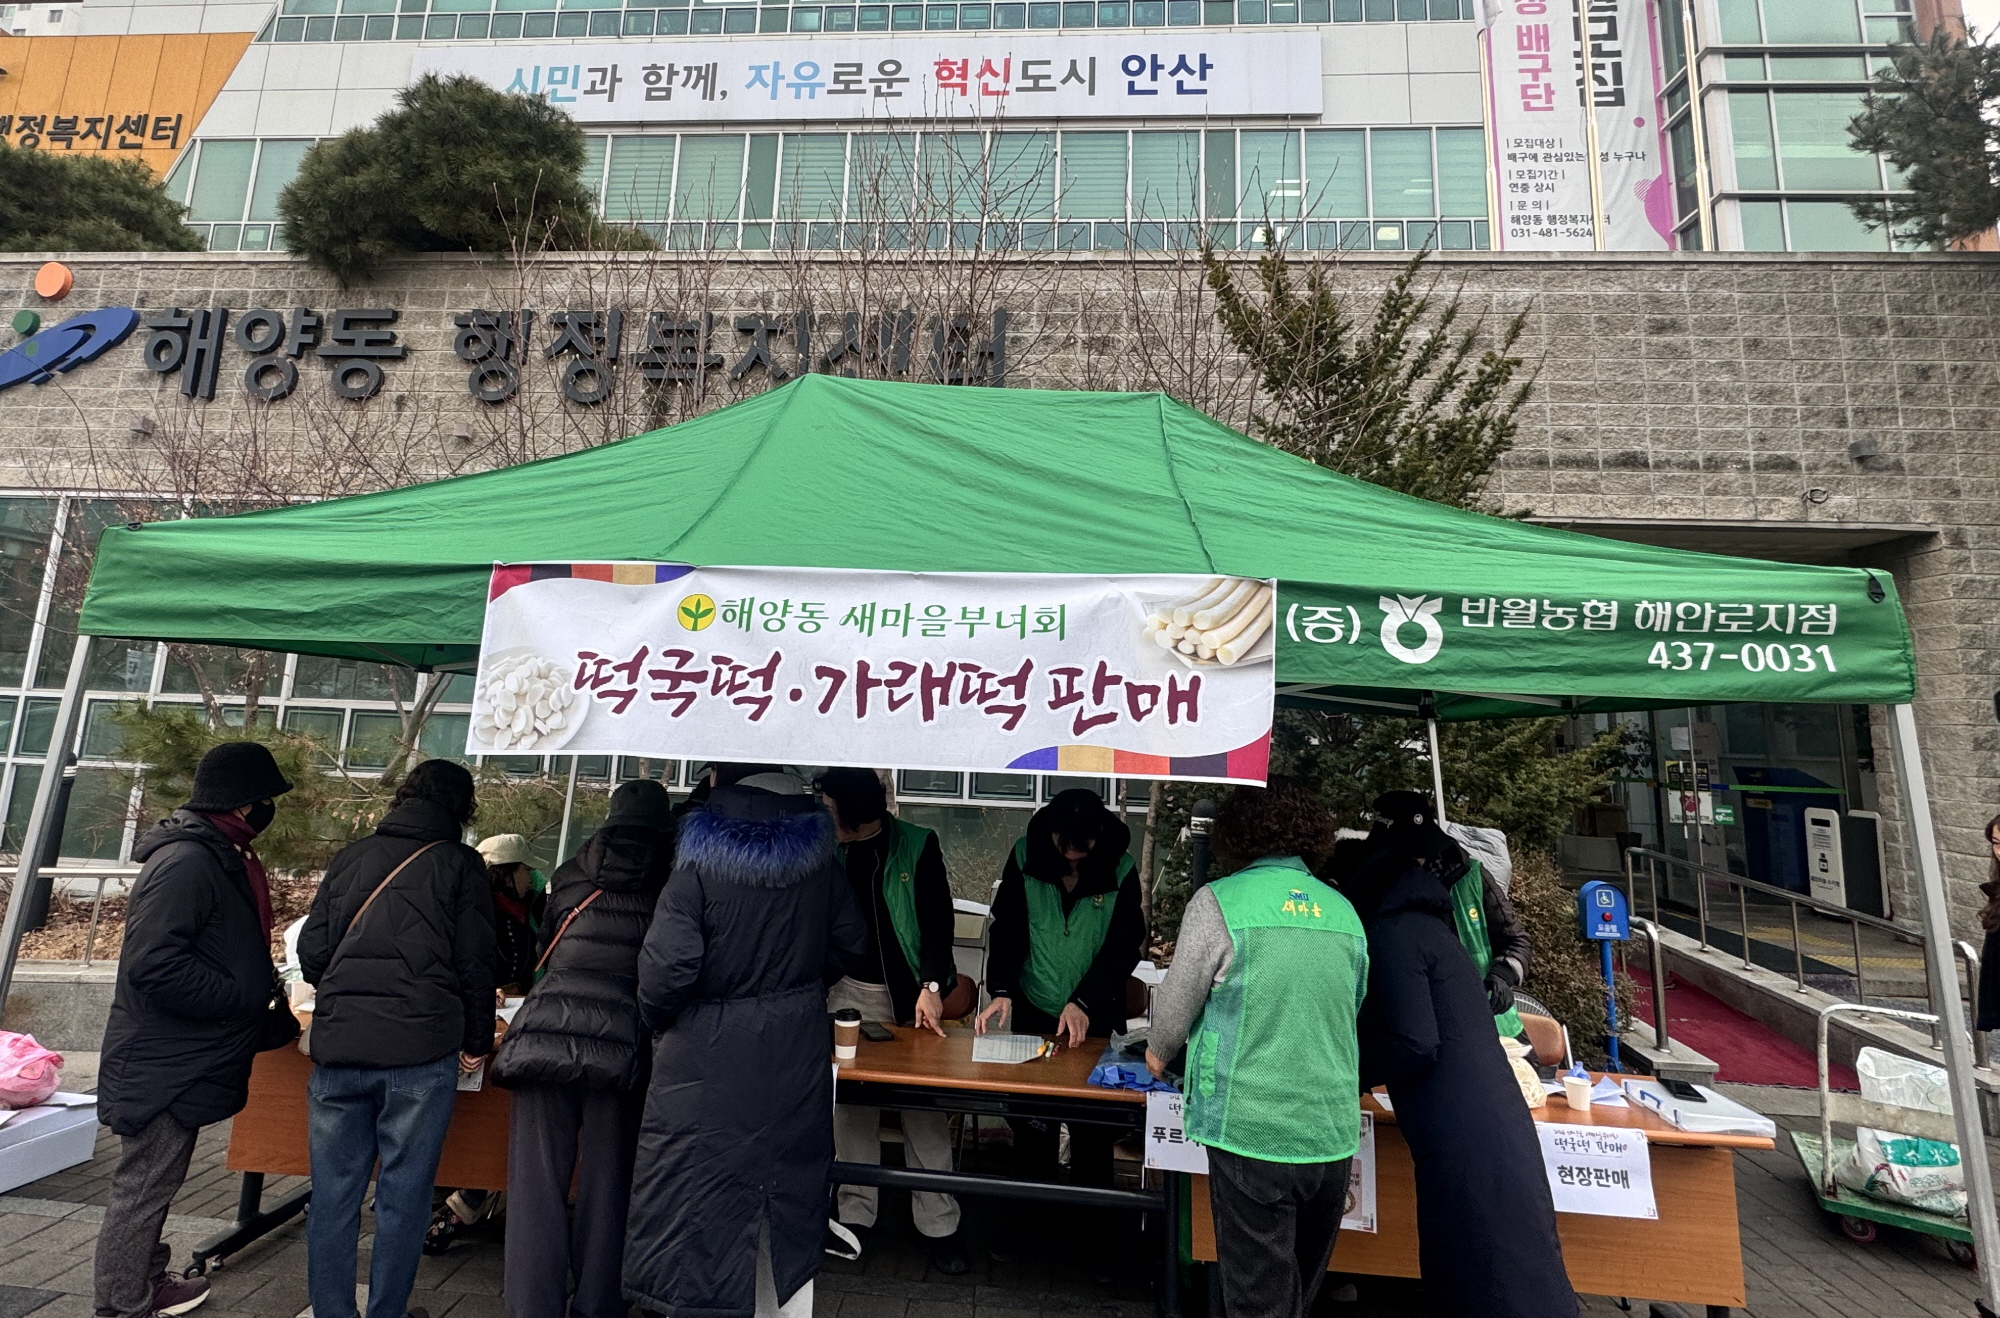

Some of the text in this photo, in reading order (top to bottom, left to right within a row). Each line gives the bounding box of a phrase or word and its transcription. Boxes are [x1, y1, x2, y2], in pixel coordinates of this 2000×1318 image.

[506, 52, 1214, 103] 시민과 함께, 자유로운 혁신도시 안산
[1516, 23, 1556, 112] 배구단
[1513, 138, 1556, 149] 모집대상
[1507, 152, 1539, 163] 배구에
[1542, 152, 1586, 162] 관심있는
[1613, 151, 1647, 162] 누구나
[1516, 169, 1559, 180] 모집기간
[1508, 182, 1555, 193] 연중 상시
[1510, 214, 1611, 225] 해양동 행정복지터
[1511, 227, 1594, 238] 031-481-5624
[143, 306, 1007, 403] 해양동 행정복지센터
[720, 596, 1067, 641] 해양동 새마을부녀회
[1285, 597, 1837, 645] (증) 반월농협 해안로지점
[1647, 641, 1837, 672] 437-0031
[1047, 659, 1202, 737] 판매
[1281, 900, 1323, 918] 새마을
[1554, 1137, 1623, 1154] 떡국떡 판매
[1557, 1165, 1630, 1189] 현장판매
